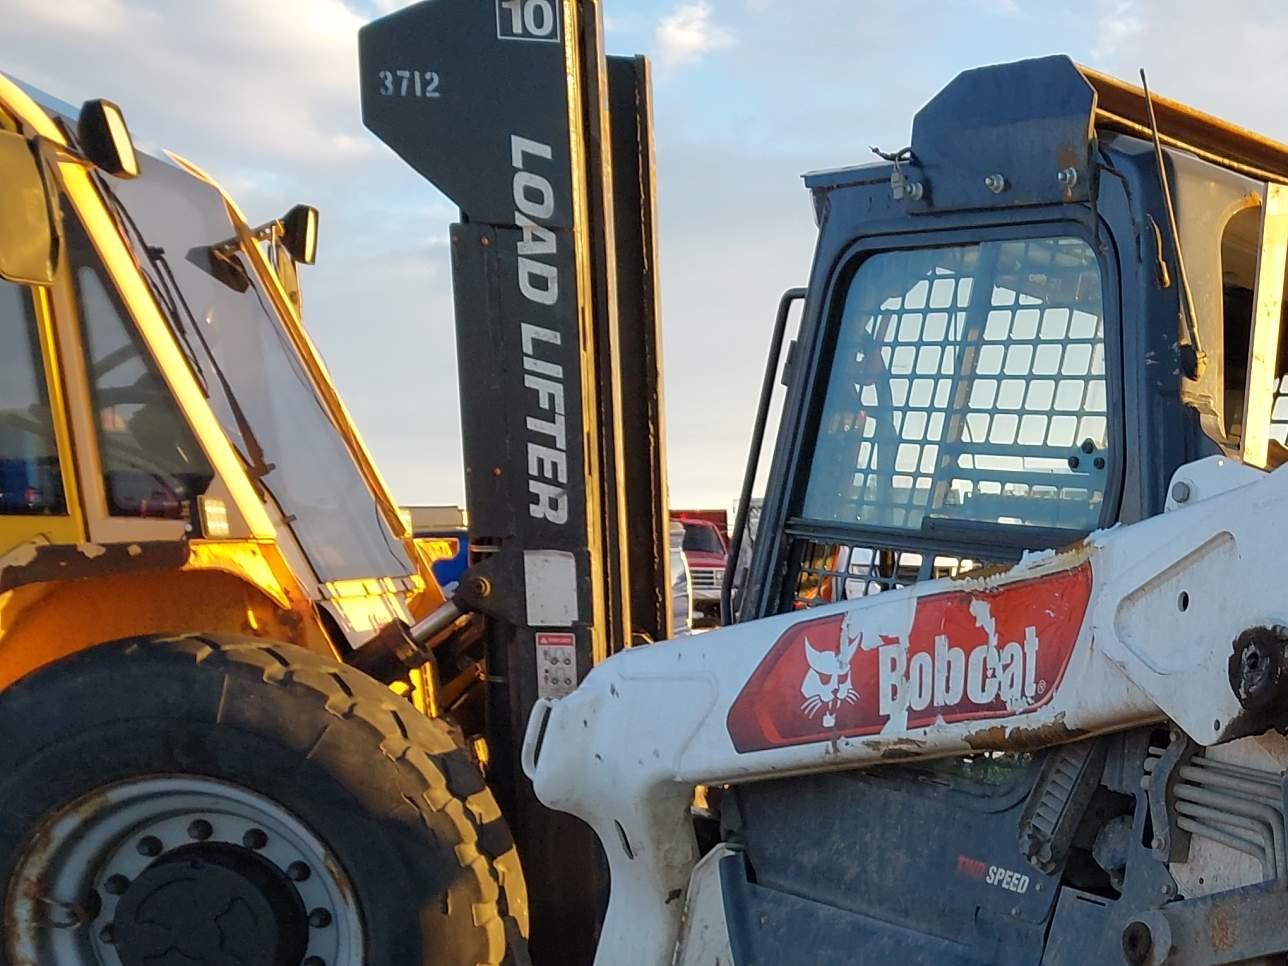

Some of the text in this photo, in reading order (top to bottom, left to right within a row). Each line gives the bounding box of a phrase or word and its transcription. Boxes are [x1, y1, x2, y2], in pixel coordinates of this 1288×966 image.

[502, 0, 554, 36] 10
[379, 70, 441, 98] 3712
[511, 134, 569, 526] LOAD LIFTER
[985, 865, 1030, 894] SPEED
